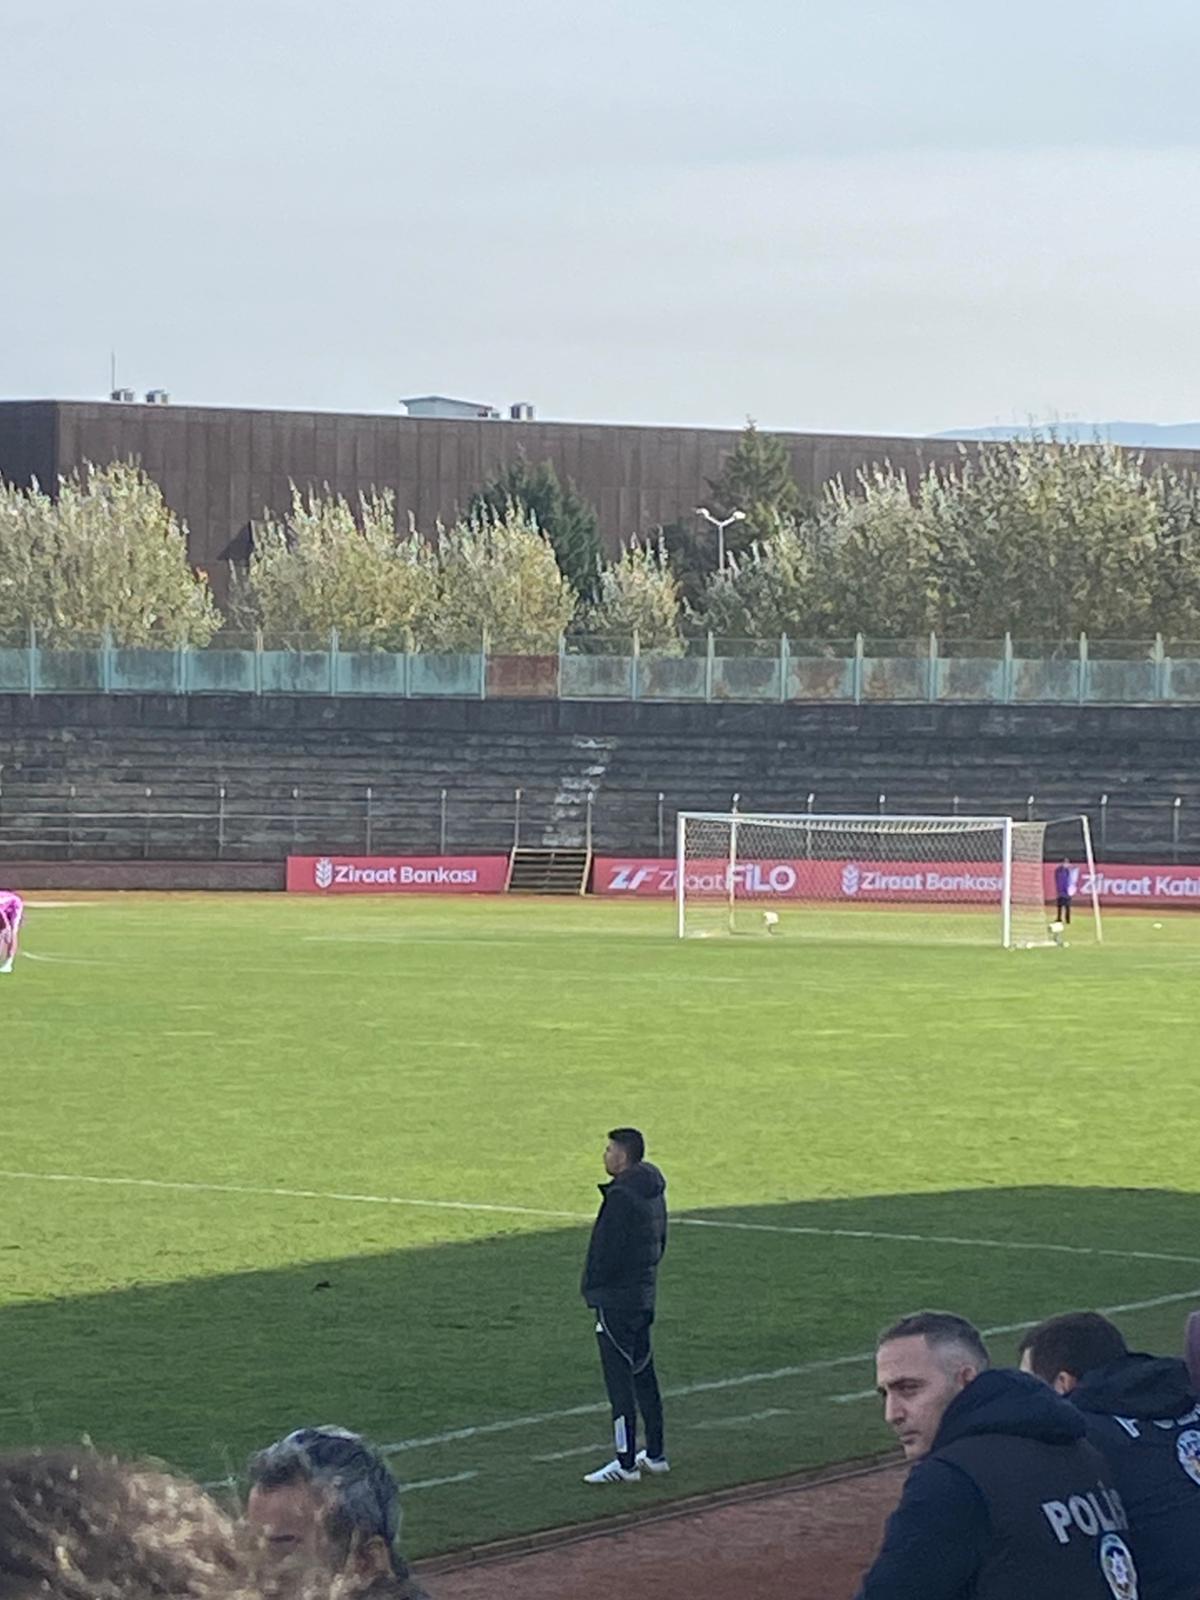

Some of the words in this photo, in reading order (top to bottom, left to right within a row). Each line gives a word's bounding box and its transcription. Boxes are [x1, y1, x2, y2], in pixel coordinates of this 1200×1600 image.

[334, 865, 397, 884] Ziraat
[399, 866, 477, 884] Bankası
[860, 872, 923, 890] Ziraat
[1079, 873, 1152, 895] Ziraat
